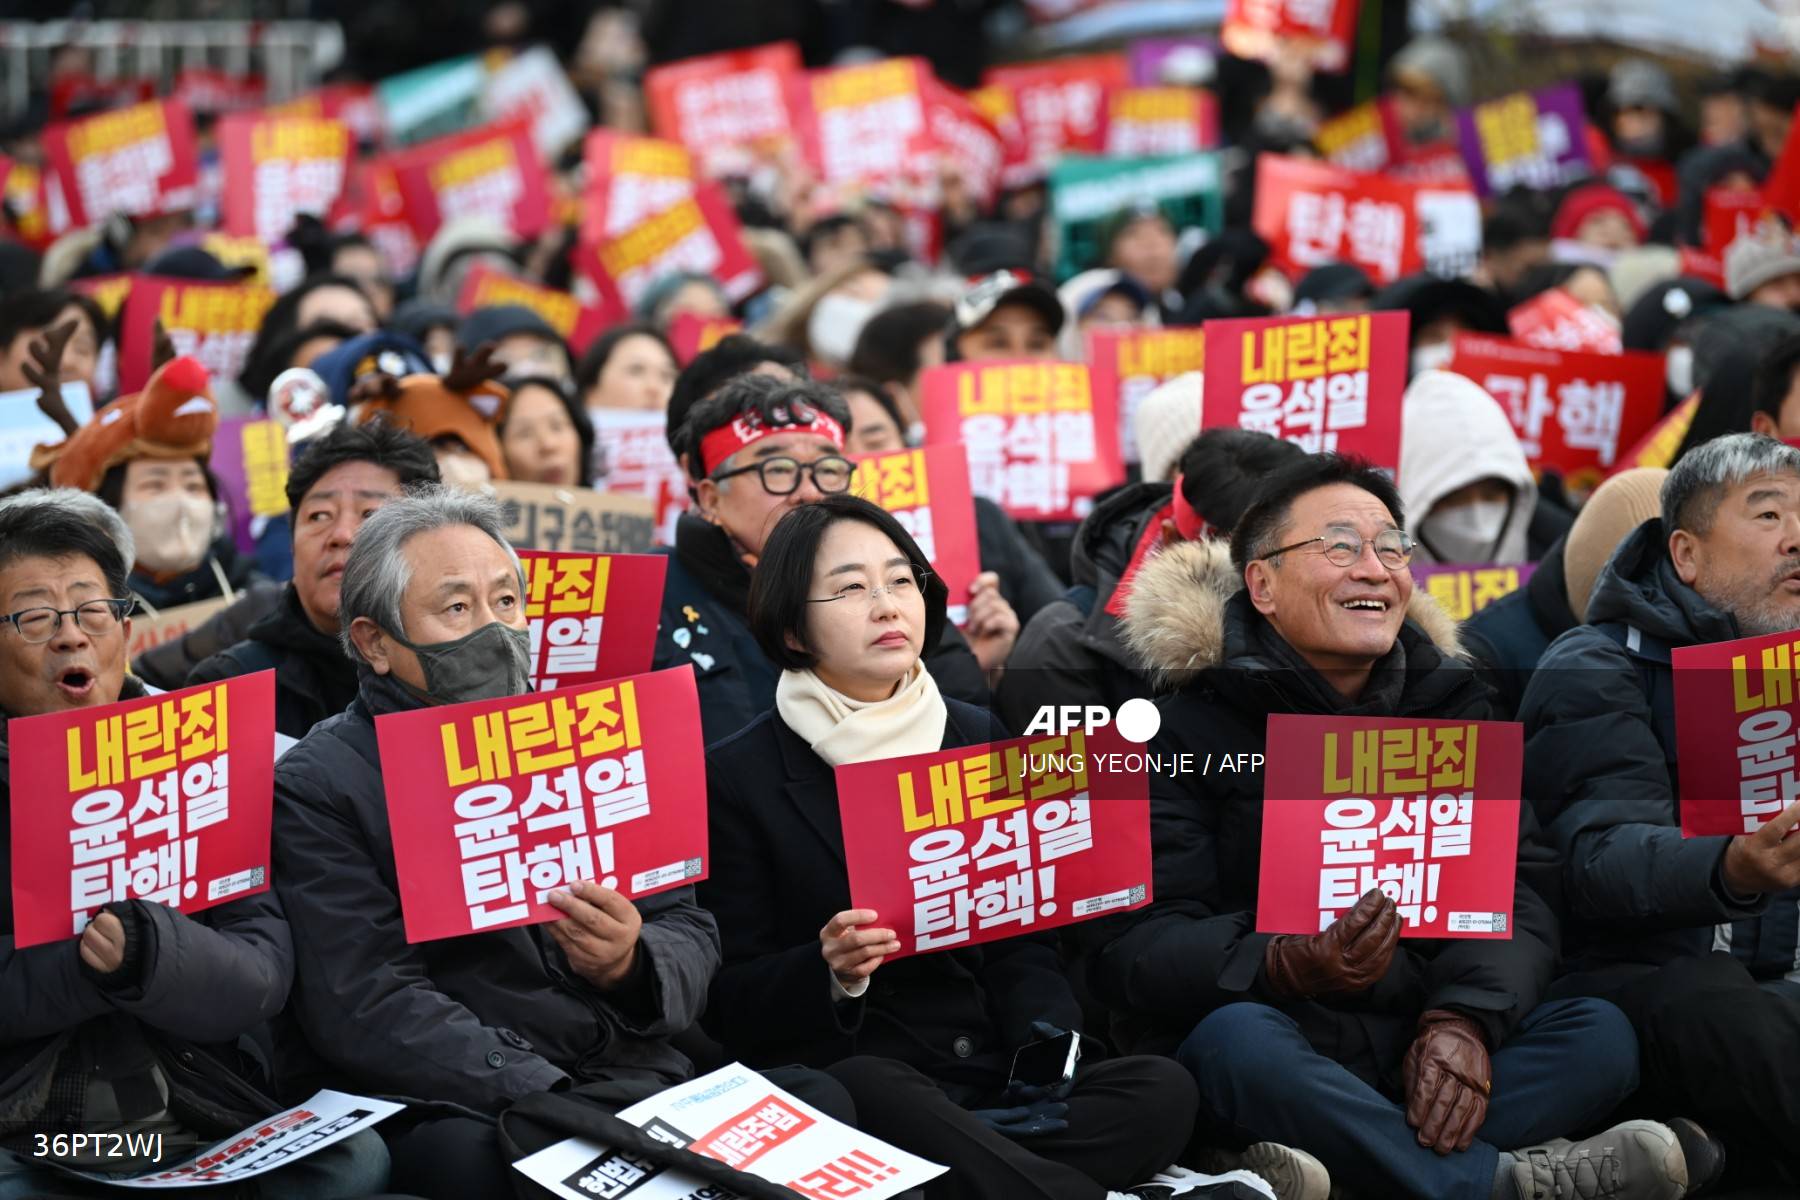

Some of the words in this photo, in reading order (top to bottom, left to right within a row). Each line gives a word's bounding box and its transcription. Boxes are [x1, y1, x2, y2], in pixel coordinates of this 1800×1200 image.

[1242, 315, 1371, 384] 내란죄
[958, 364, 1091, 417] 내란죄
[1239, 371, 1369, 440] 윤석열
[1732, 640, 1800, 713] 내
[66, 683, 229, 793] 내란죄
[440, 680, 642, 787] 내란죄
[1323, 724, 1478, 794] 내란죄
[1736, 710, 1800, 778] 윤
[69, 753, 229, 865] 윤석열
[453, 749, 651, 860] 윤석열
[897, 729, 1089, 832] 내란죄
[908, 790, 1093, 899] 윤석열
[1320, 791, 1474, 865] 윤석열
[70, 836, 199, 935] 탄핵!
[460, 832, 618, 930] 탄핵!
[913, 864, 1057, 951] 탄핵!
[1318, 862, 1441, 932] 탄핵!
[701, 1102, 802, 1167] 내란주범
